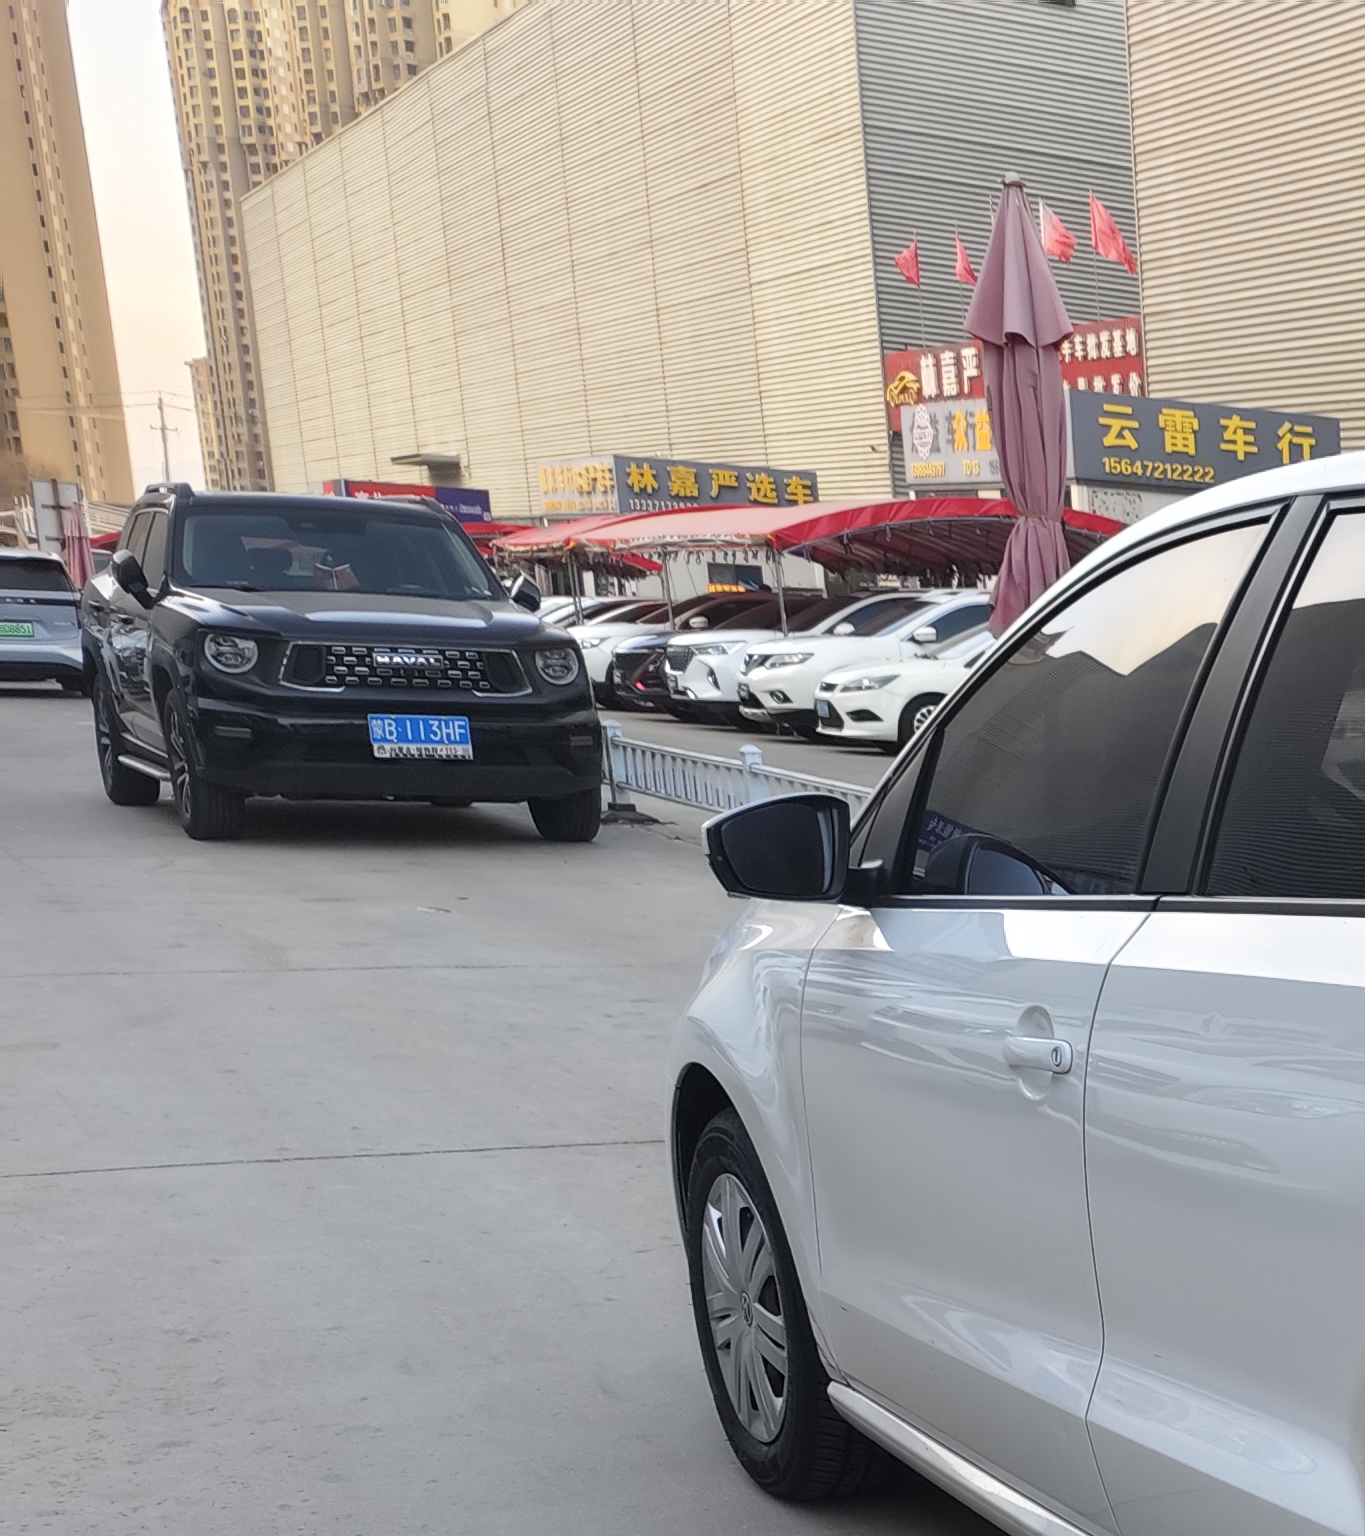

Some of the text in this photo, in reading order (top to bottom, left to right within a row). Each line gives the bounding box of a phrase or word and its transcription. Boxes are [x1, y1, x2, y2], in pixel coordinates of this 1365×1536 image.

[1059, 327, 1140, 364] 手车批发基地
[1098, 402, 1317, 465] 云雷车行
[626, 461, 813, 505] 林嘉严选车
[1101, 456, 1215, 484] 15647212222
[375, 655, 440, 668] HAVAL
